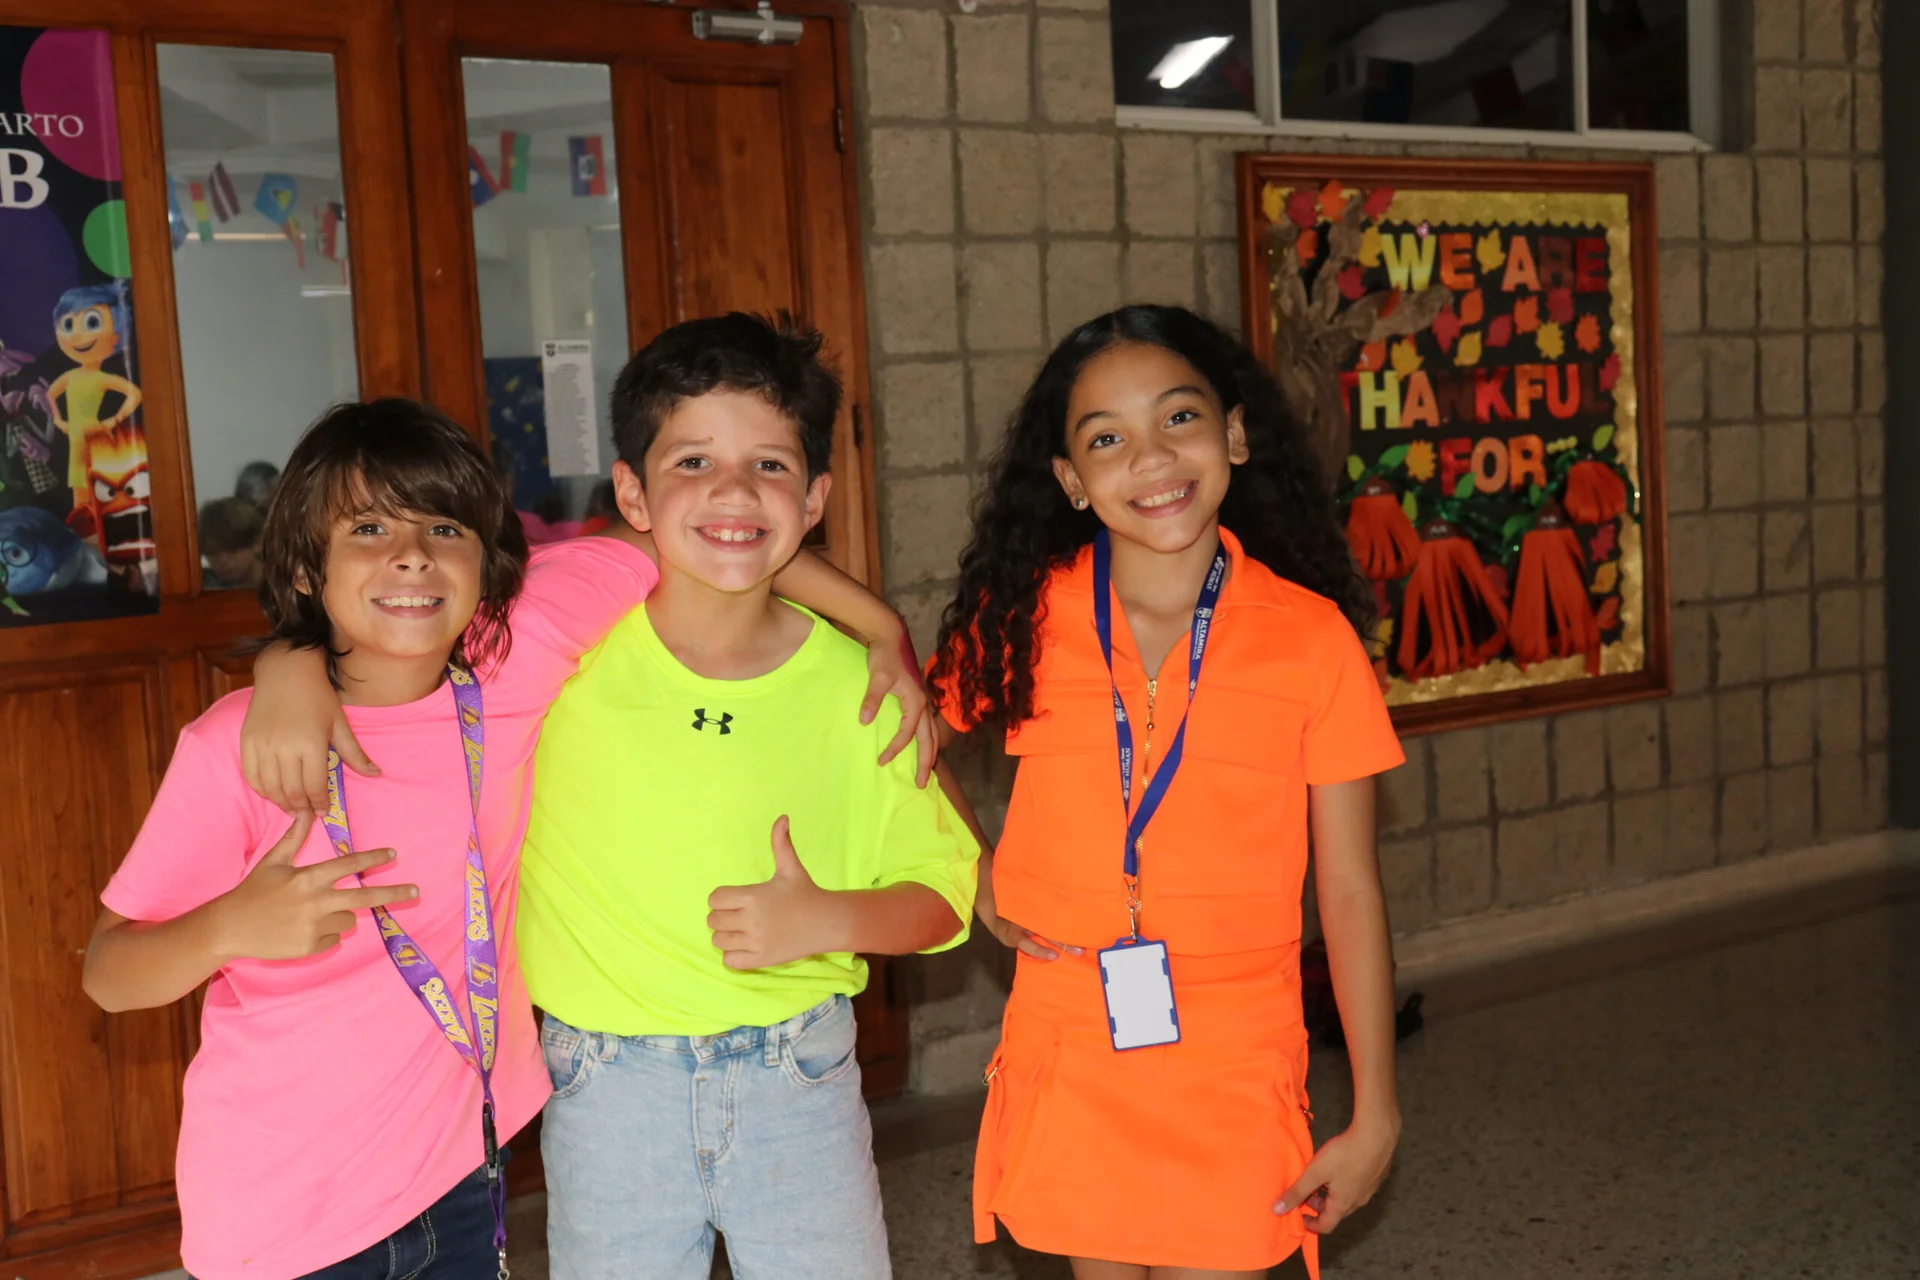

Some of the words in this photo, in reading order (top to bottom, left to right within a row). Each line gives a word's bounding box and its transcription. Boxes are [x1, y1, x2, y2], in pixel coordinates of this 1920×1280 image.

[1380, 233, 1476, 291] WE
[1501, 235, 1607, 292] ARE
[1195, 619, 1209, 660] ALTAMIRA
[465, 859, 489, 942] LAKERS
[419, 976, 472, 1049] LAKERS
[469, 990, 498, 1073] LAKERS
